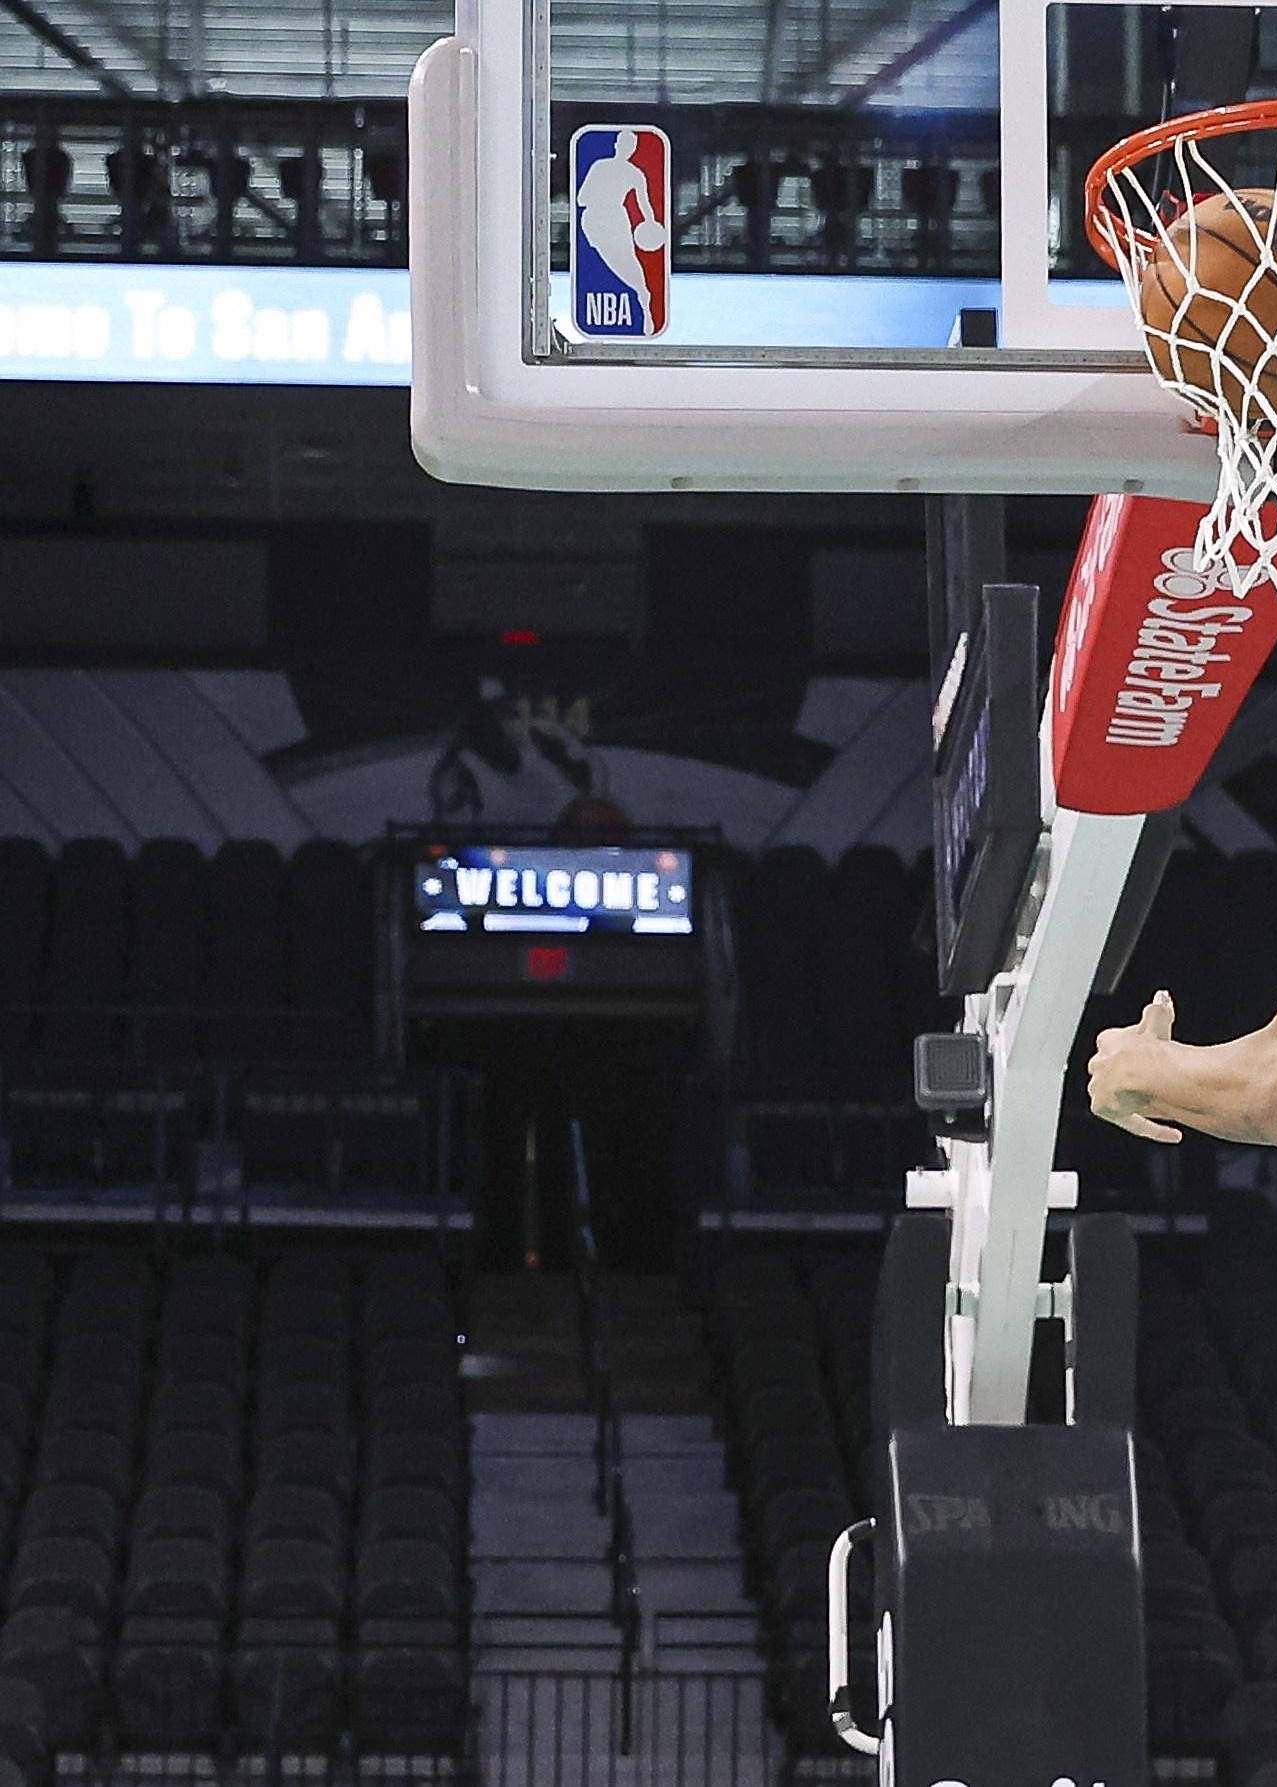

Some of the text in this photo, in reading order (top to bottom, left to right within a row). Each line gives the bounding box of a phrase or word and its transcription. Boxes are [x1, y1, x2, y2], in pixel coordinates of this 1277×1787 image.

[586, 292, 632, 326] NBA
[456, 867, 661, 911] WELCOME
[906, 1495, 1122, 1534] SPAING
